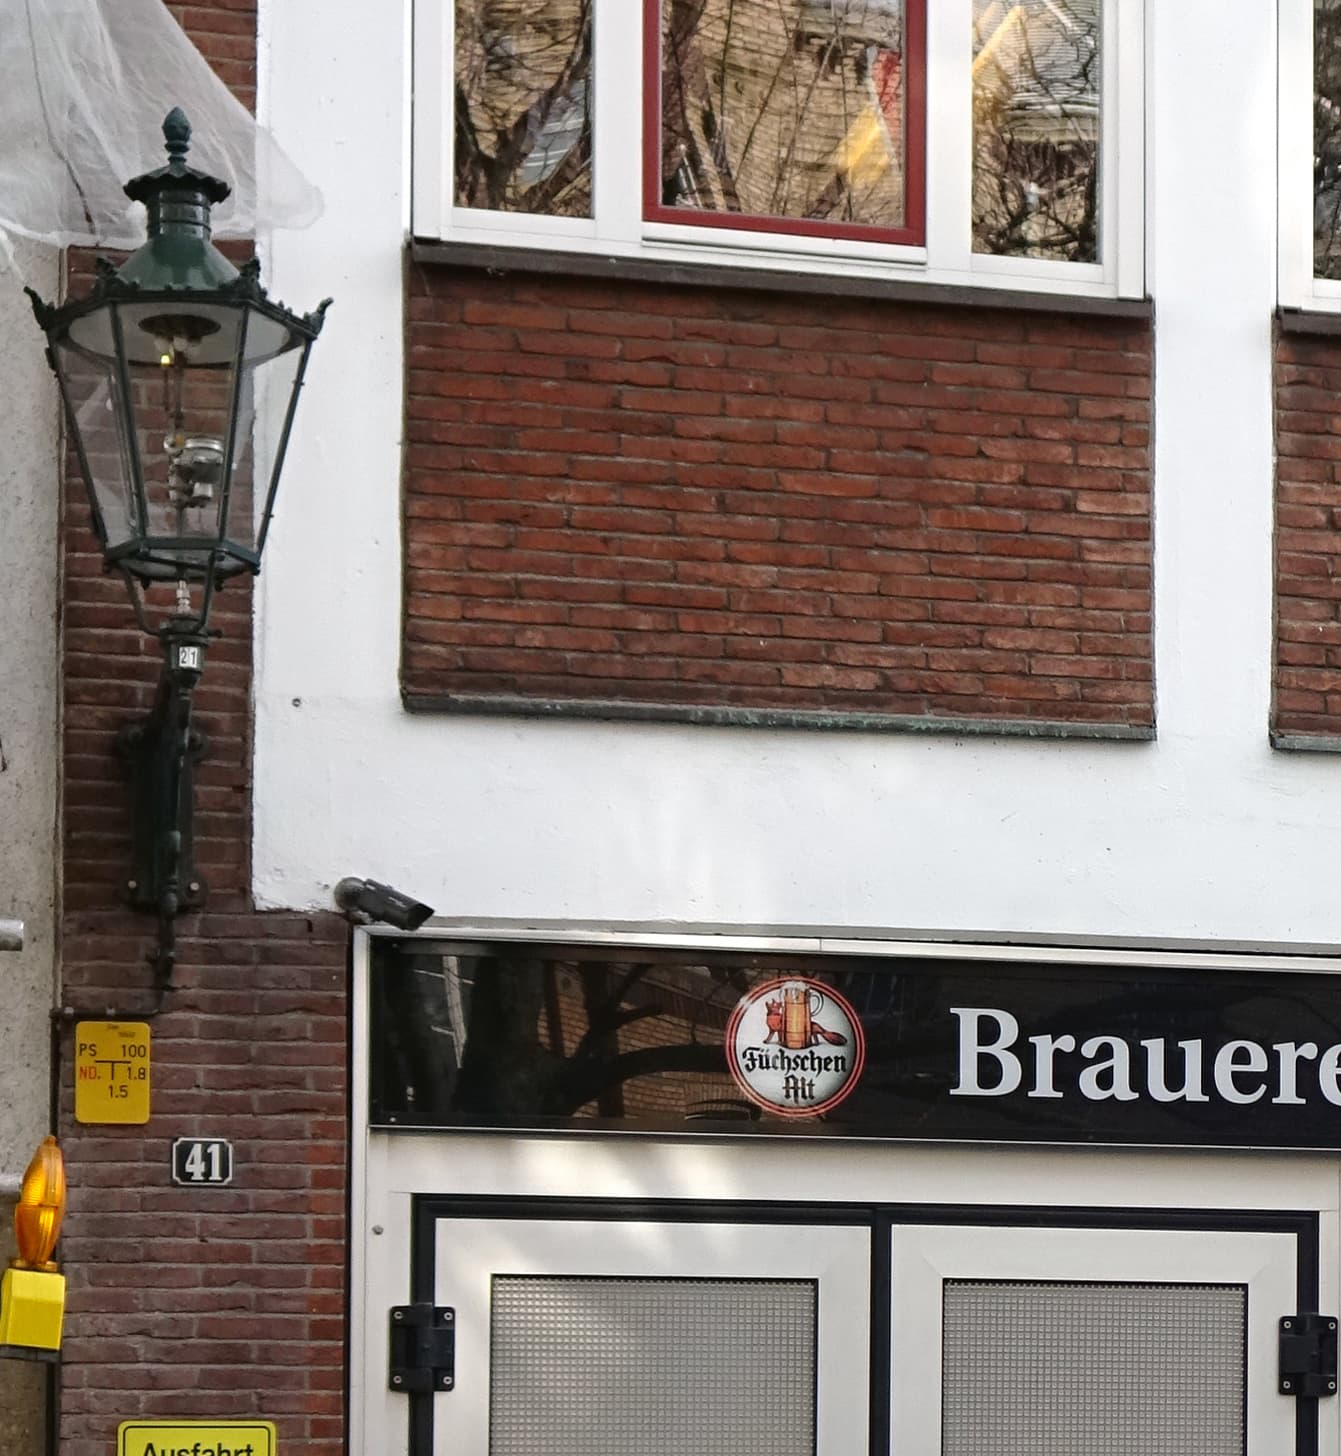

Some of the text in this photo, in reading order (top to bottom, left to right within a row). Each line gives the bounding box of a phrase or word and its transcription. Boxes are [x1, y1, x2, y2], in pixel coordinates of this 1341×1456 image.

[180, 648, 197, 665] 21
[79, 1043, 147, 1058] PS 100
[742, 1046, 847, 1078] Füchschen
[126, 1066, 146, 1081] 1.8
[108, 1084, 129, 1099] 1.5
[782, 1074, 816, 1105] Alt
[185, 1143, 222, 1181] 41
